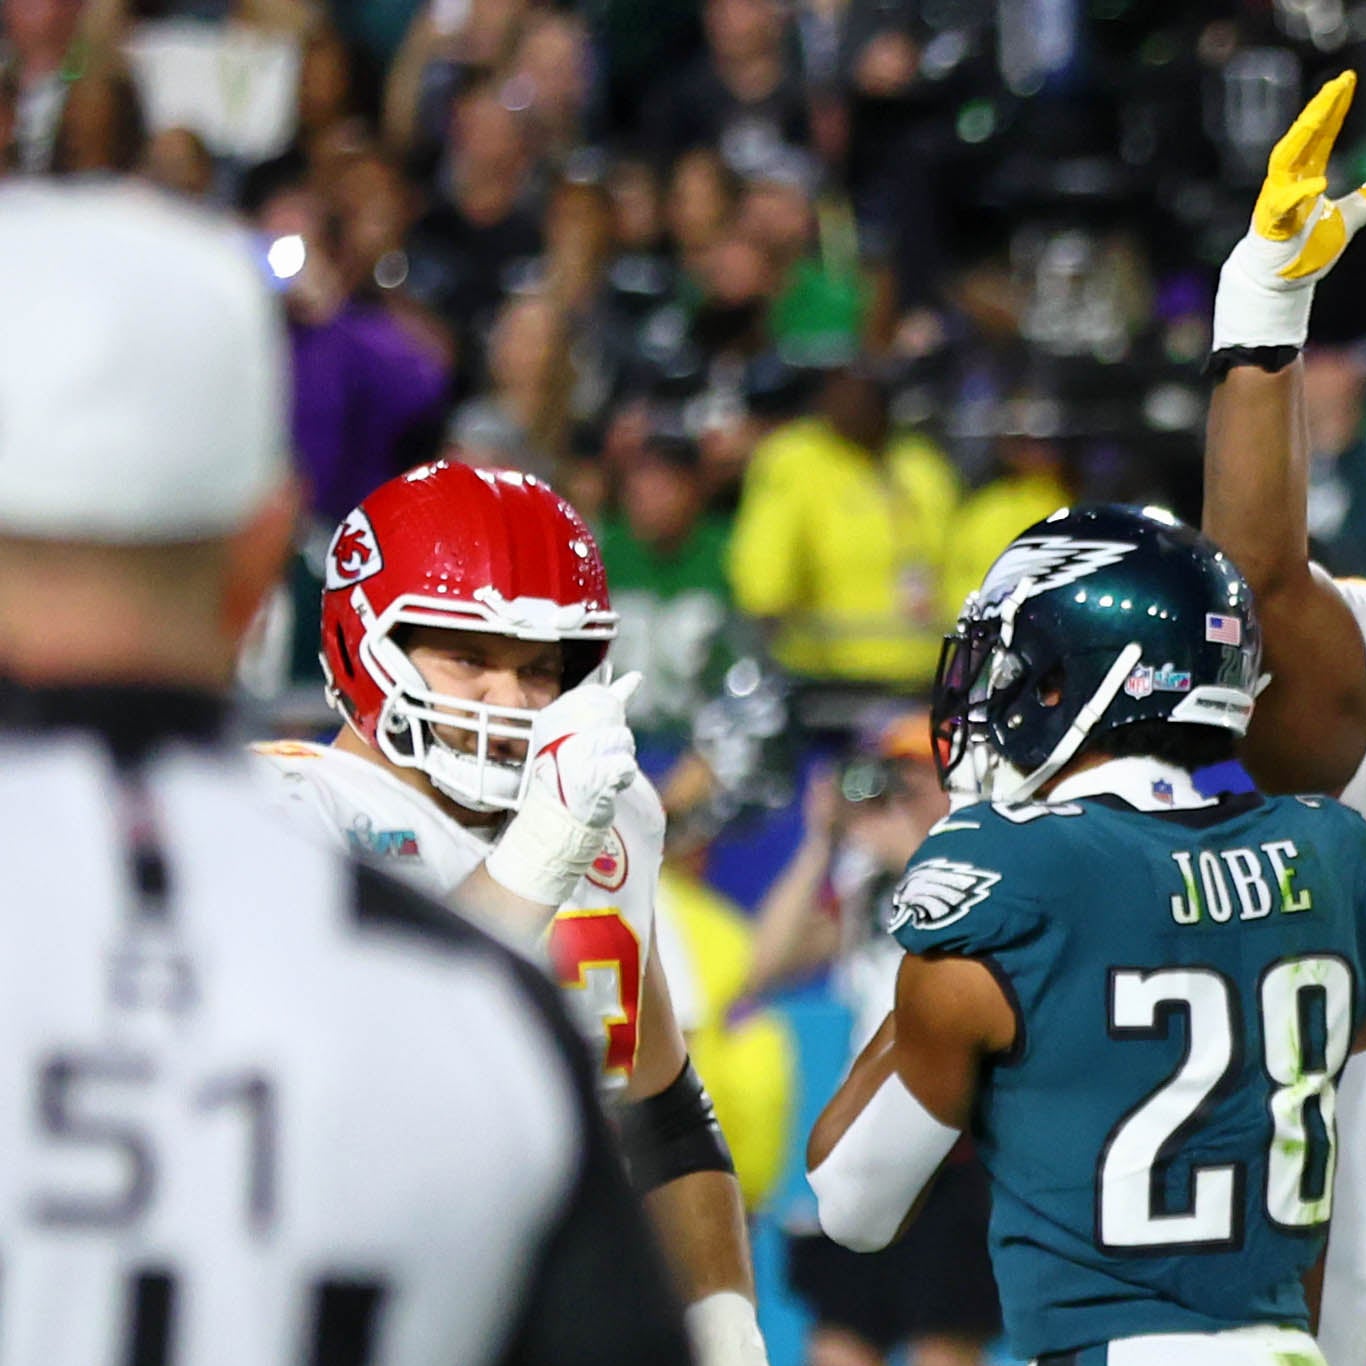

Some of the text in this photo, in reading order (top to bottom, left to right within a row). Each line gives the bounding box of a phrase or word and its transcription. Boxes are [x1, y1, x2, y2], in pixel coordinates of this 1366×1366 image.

[1170, 839, 1313, 925] JOBE
[32, 1045, 282, 1238] 51
[1094, 953, 1358, 1256] 28
